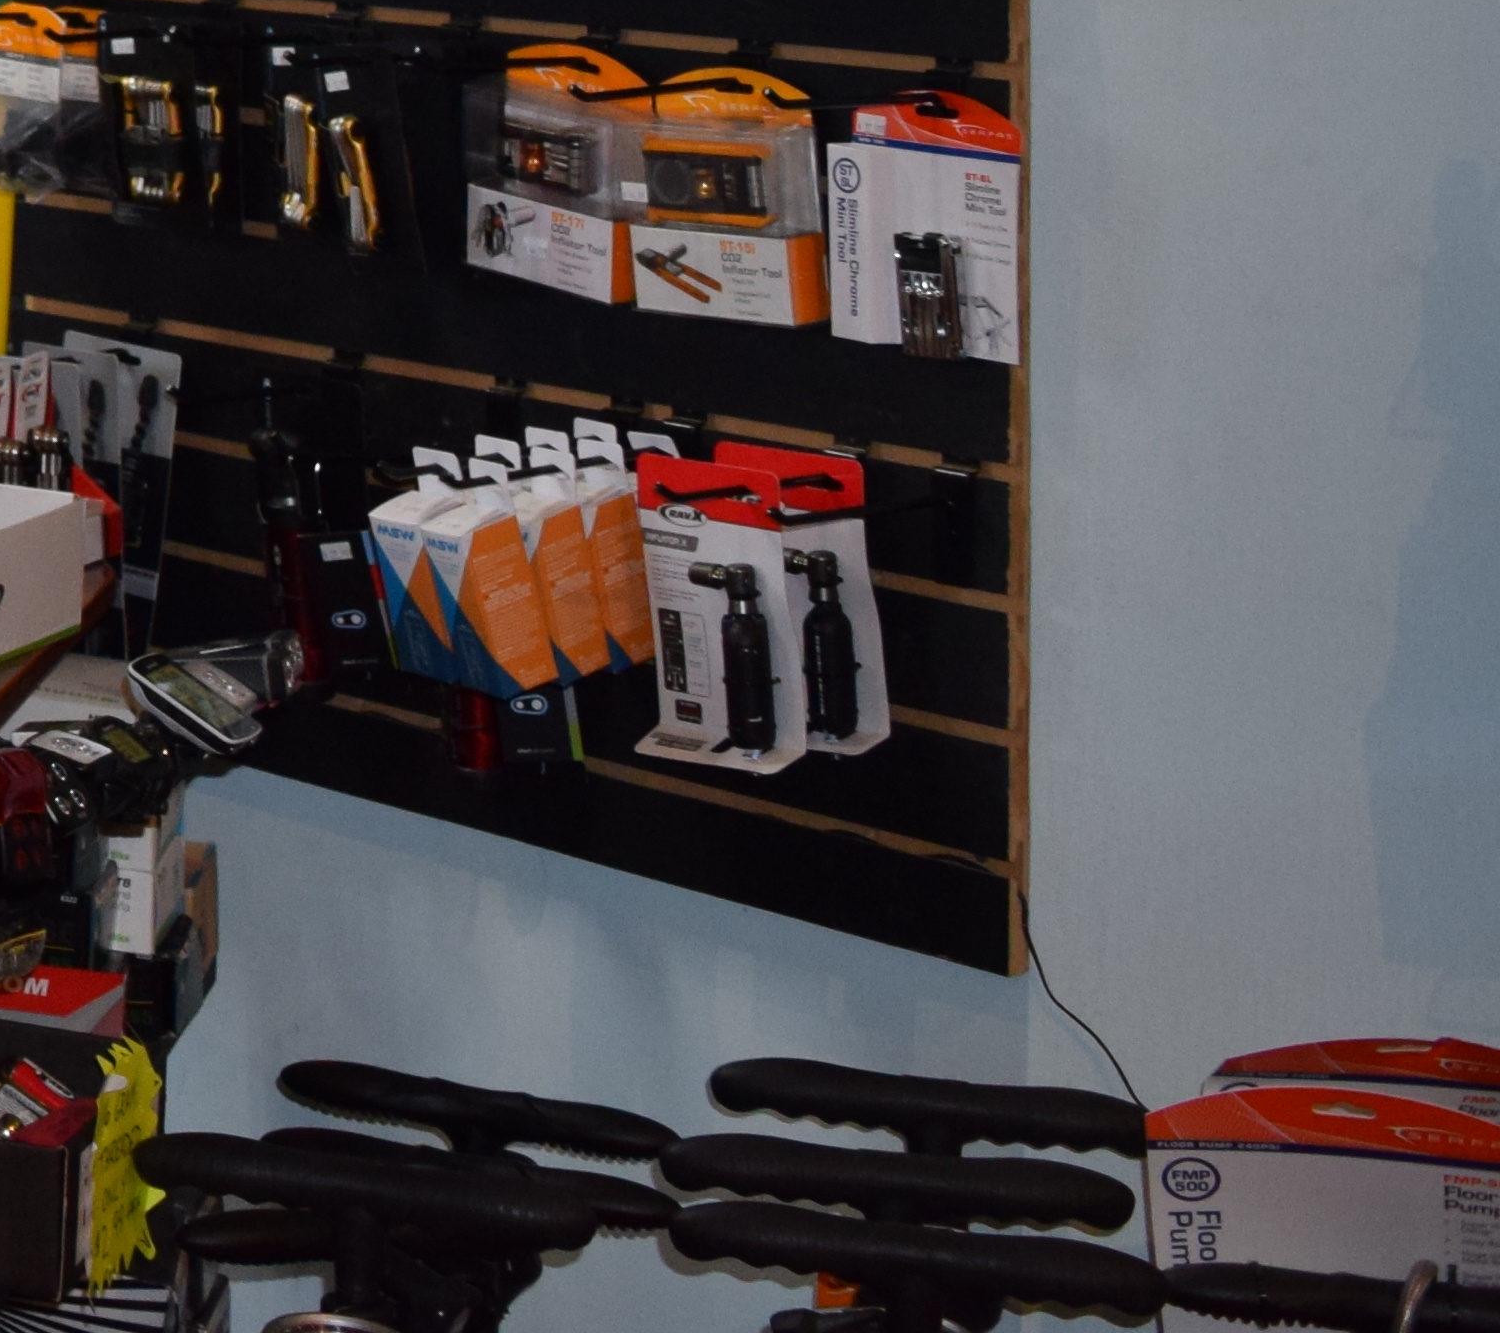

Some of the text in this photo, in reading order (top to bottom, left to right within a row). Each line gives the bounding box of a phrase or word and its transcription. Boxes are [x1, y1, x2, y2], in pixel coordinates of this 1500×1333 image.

[835, 196, 847, 264] Mini Tool
[550, 235, 608, 256] Inflator Tool
[847, 198, 861, 318] Slimline Chrome
[721, 263, 783, 279] Inflator Tool
[376, 526, 415, 542] MSW
[427, 536, 459, 554] MSW
[1157, 1141, 1201, 1149] FLOOR
[1202, 1142, 1234, 1150] PUMP
[1171, 1169, 1211, 1181] FMP
[1175, 1182, 1209, 1192] 500
[1443, 1185, 1499, 1202] Floor
